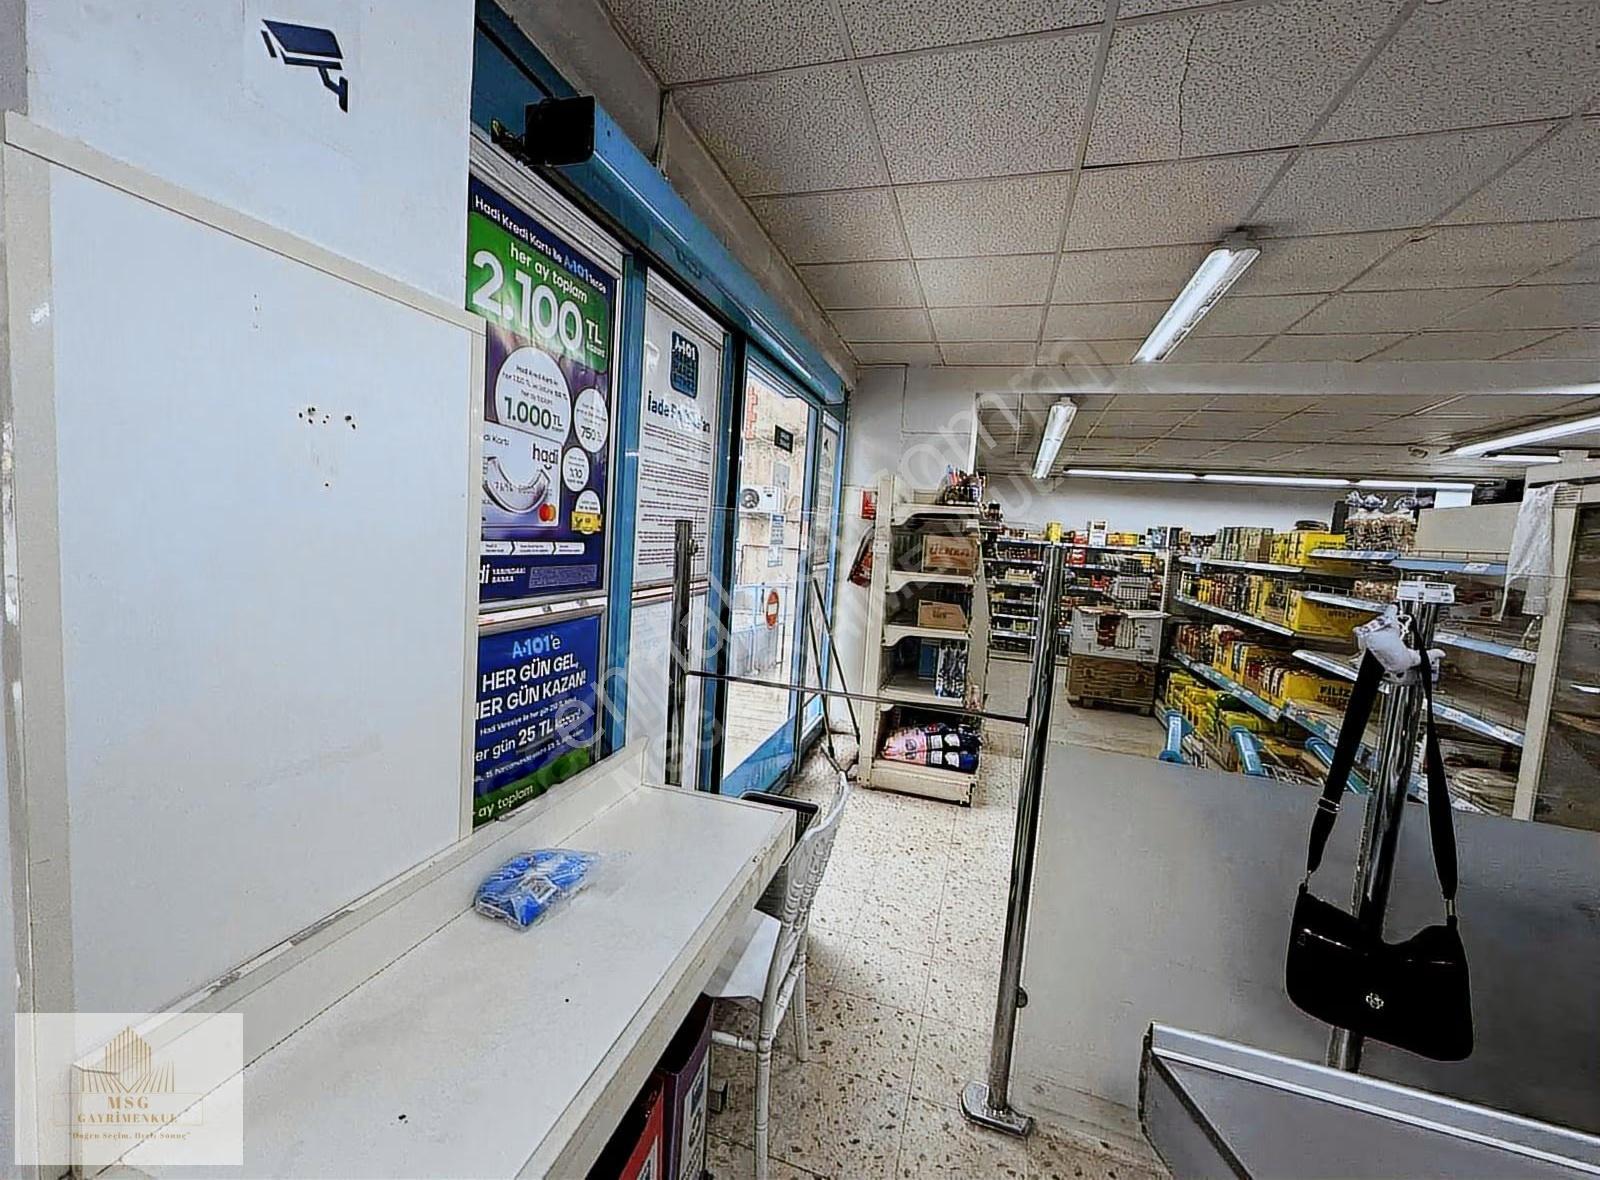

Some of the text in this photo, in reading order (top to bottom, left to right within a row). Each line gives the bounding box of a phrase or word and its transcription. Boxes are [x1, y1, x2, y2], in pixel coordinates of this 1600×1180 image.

[475, 194, 501, 221] Hadi
[502, 214, 528, 240] Kredi
[510, 241, 588, 304] her ay toplam
[473, 250, 602, 351] 2.100 TL
[504, 395, 551, 430] 1.000
[553, 414, 563, 427] TL
[532, 443, 559, 465] hadi
[482, 653, 579, 692] HER GÜN GEL,
[506, 684, 539, 710] GÜN
[542, 669, 586, 699] KAZAN!
[475, 748, 490, 762] er
[492, 739, 516, 760] gün
[518, 725, 536, 746] 25
[539, 718, 554, 737] TL
[478, 785, 533, 818] ay toplam
